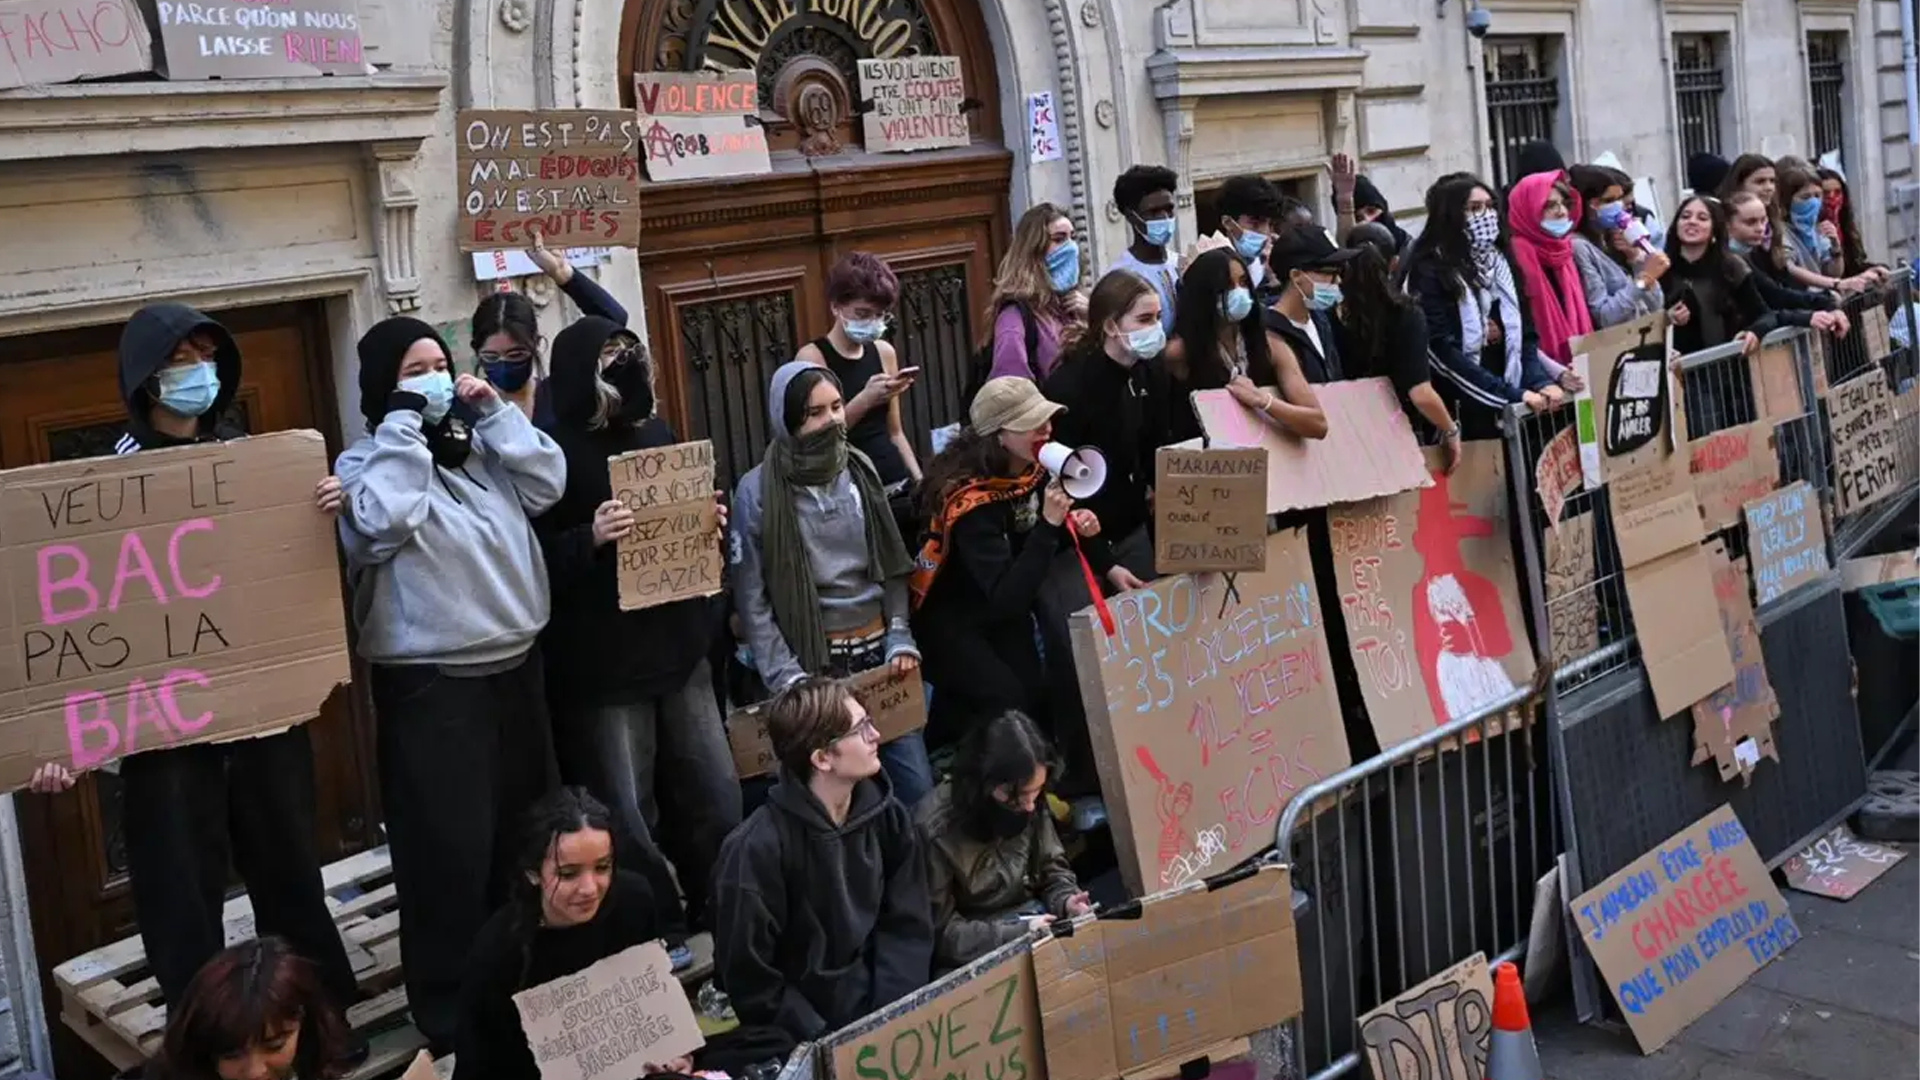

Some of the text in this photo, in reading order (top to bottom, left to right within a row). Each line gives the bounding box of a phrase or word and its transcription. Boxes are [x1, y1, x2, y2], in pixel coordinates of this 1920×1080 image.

[159, 2, 231, 26] PARCE
[304, 11, 358, 30] NOUS
[199, 31, 360, 63] LAISSE RIEN
[884, 61, 955, 80] VOULAIENT
[898, 99, 922, 115] ONT
[466, 116, 632, 151] ON EST PAS
[471, 158, 537, 185] MAL
[466, 184, 629, 214] ON EST MAL
[475, 208, 620, 242] ÉCOUTÉS
[618, 452, 666, 481] TROP
[1167, 457, 1264, 474] MARIANNE
[42, 460, 235, 528] VEUT LE
[617, 485, 658, 512] POUR
[1179, 484, 1230, 505] AS TU
[1216, 526, 1239, 535] TES
[37, 517, 221, 625] BAC
[621, 545, 659, 572] POUR
[663, 542, 678, 561] SE
[636, 557, 714, 595] GAZER
[1353, 558, 1380, 592] ET
[24, 613, 230, 681] PAS LA
[1125, 648, 1174, 712] 35
[64, 668, 214, 767] BAC
[1658, 839, 1701, 882] ÊTRE
[1631, 857, 1749, 961] CHARGÉE
[1746, 913, 1799, 964] TEMPS
[1618, 968, 1664, 1014] QUE
[1660, 943, 1700, 987] MON
[1695, 907, 1748, 961] EMPLOI
[856, 973, 1023, 1080] SOYEZ
